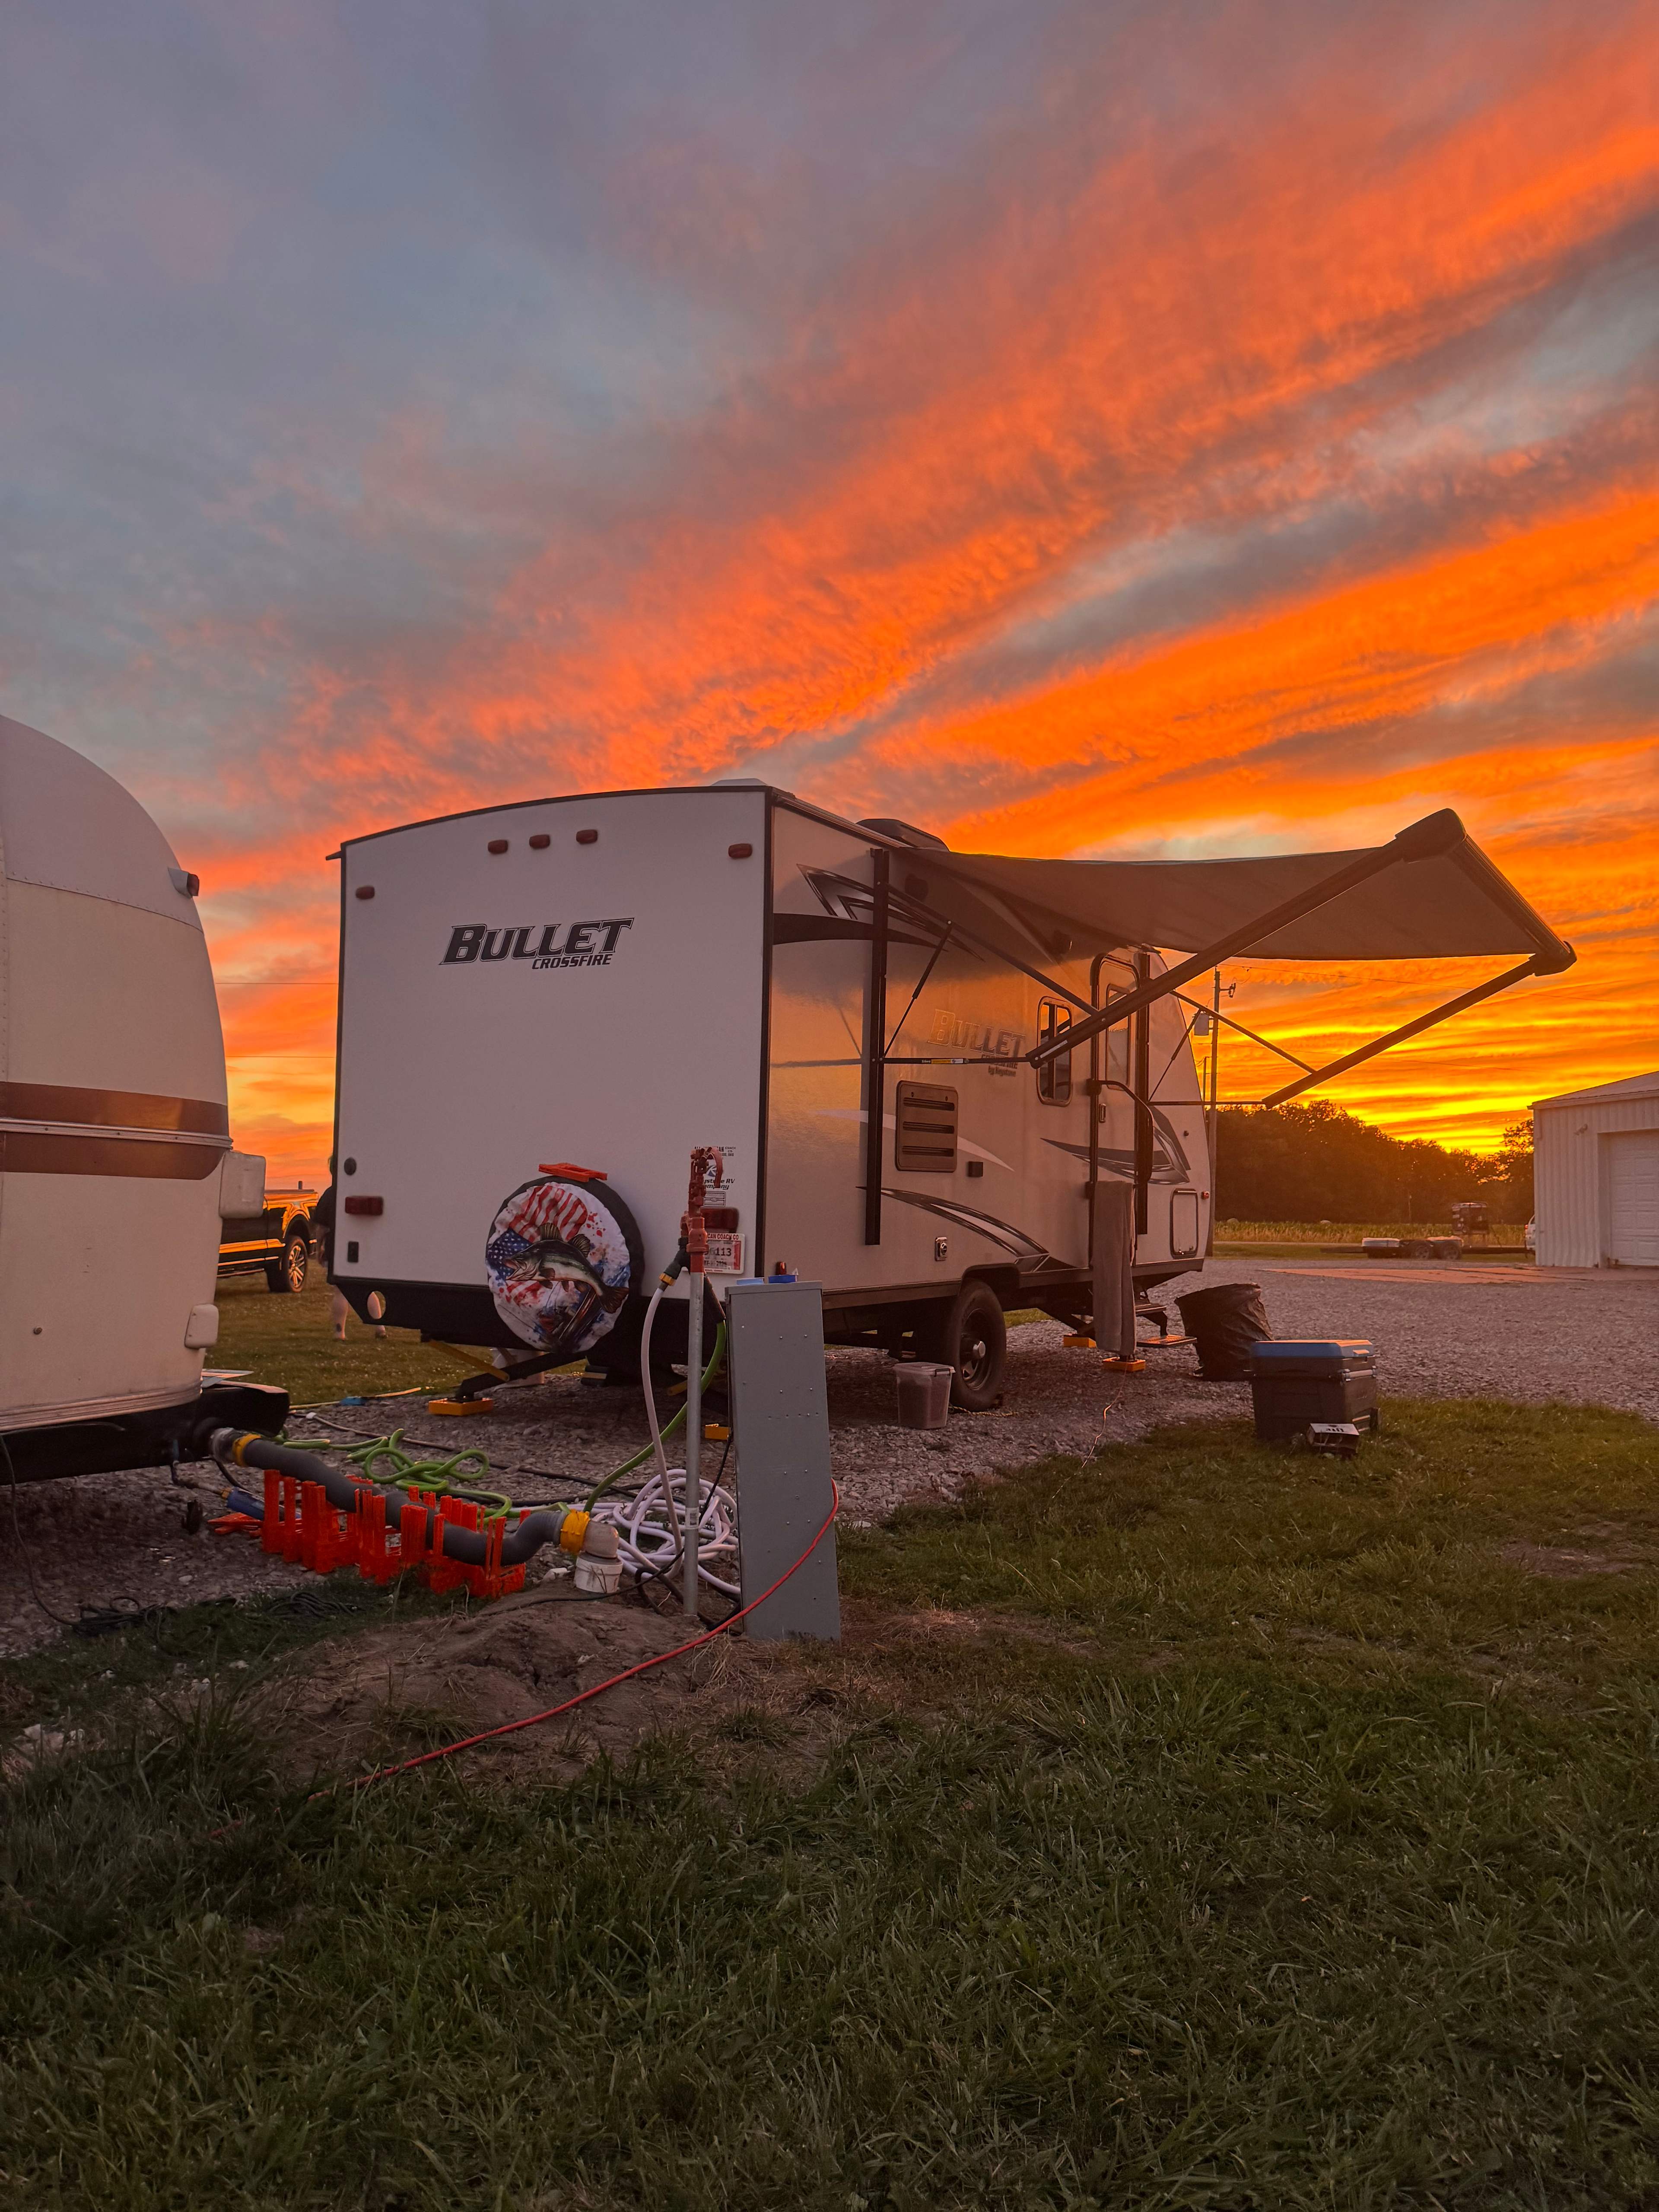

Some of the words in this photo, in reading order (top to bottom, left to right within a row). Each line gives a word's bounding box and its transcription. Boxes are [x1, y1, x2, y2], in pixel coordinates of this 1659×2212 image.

[439, 918, 634, 965] BULLET
[532, 954, 613, 969] CROSSFIRE
[927, 1009, 1026, 1058] BULLET
